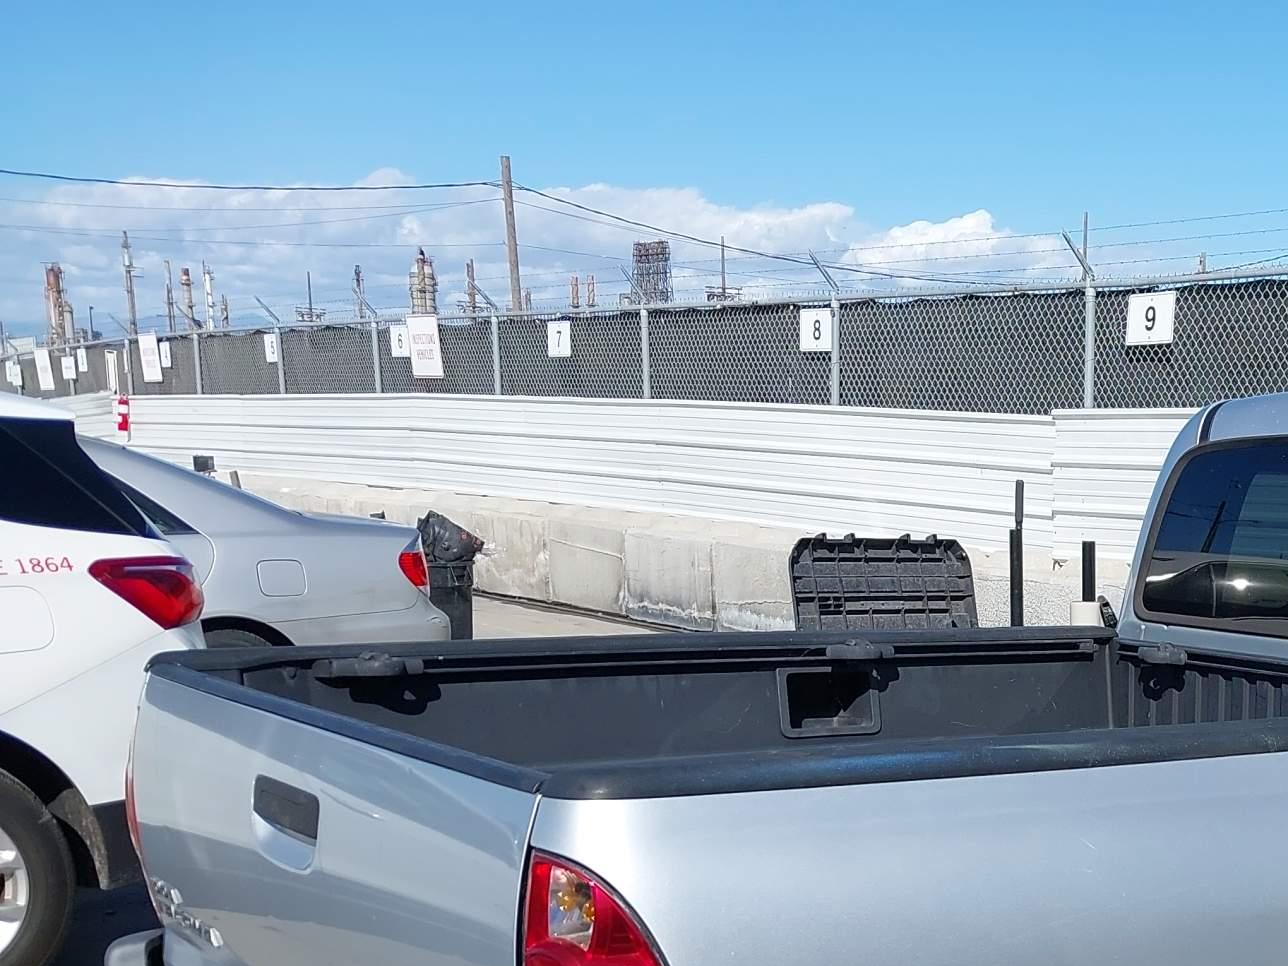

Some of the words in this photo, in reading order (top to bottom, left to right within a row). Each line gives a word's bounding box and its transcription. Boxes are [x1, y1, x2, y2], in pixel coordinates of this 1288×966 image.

[1143, 306, 1154, 331] 9
[813, 319, 821, 340] 8
[270, 340, 276, 355] 5
[397, 333, 403, 349] 6
[556, 331, 562, 348] 7
[15, 556, 74, 574] 1864
